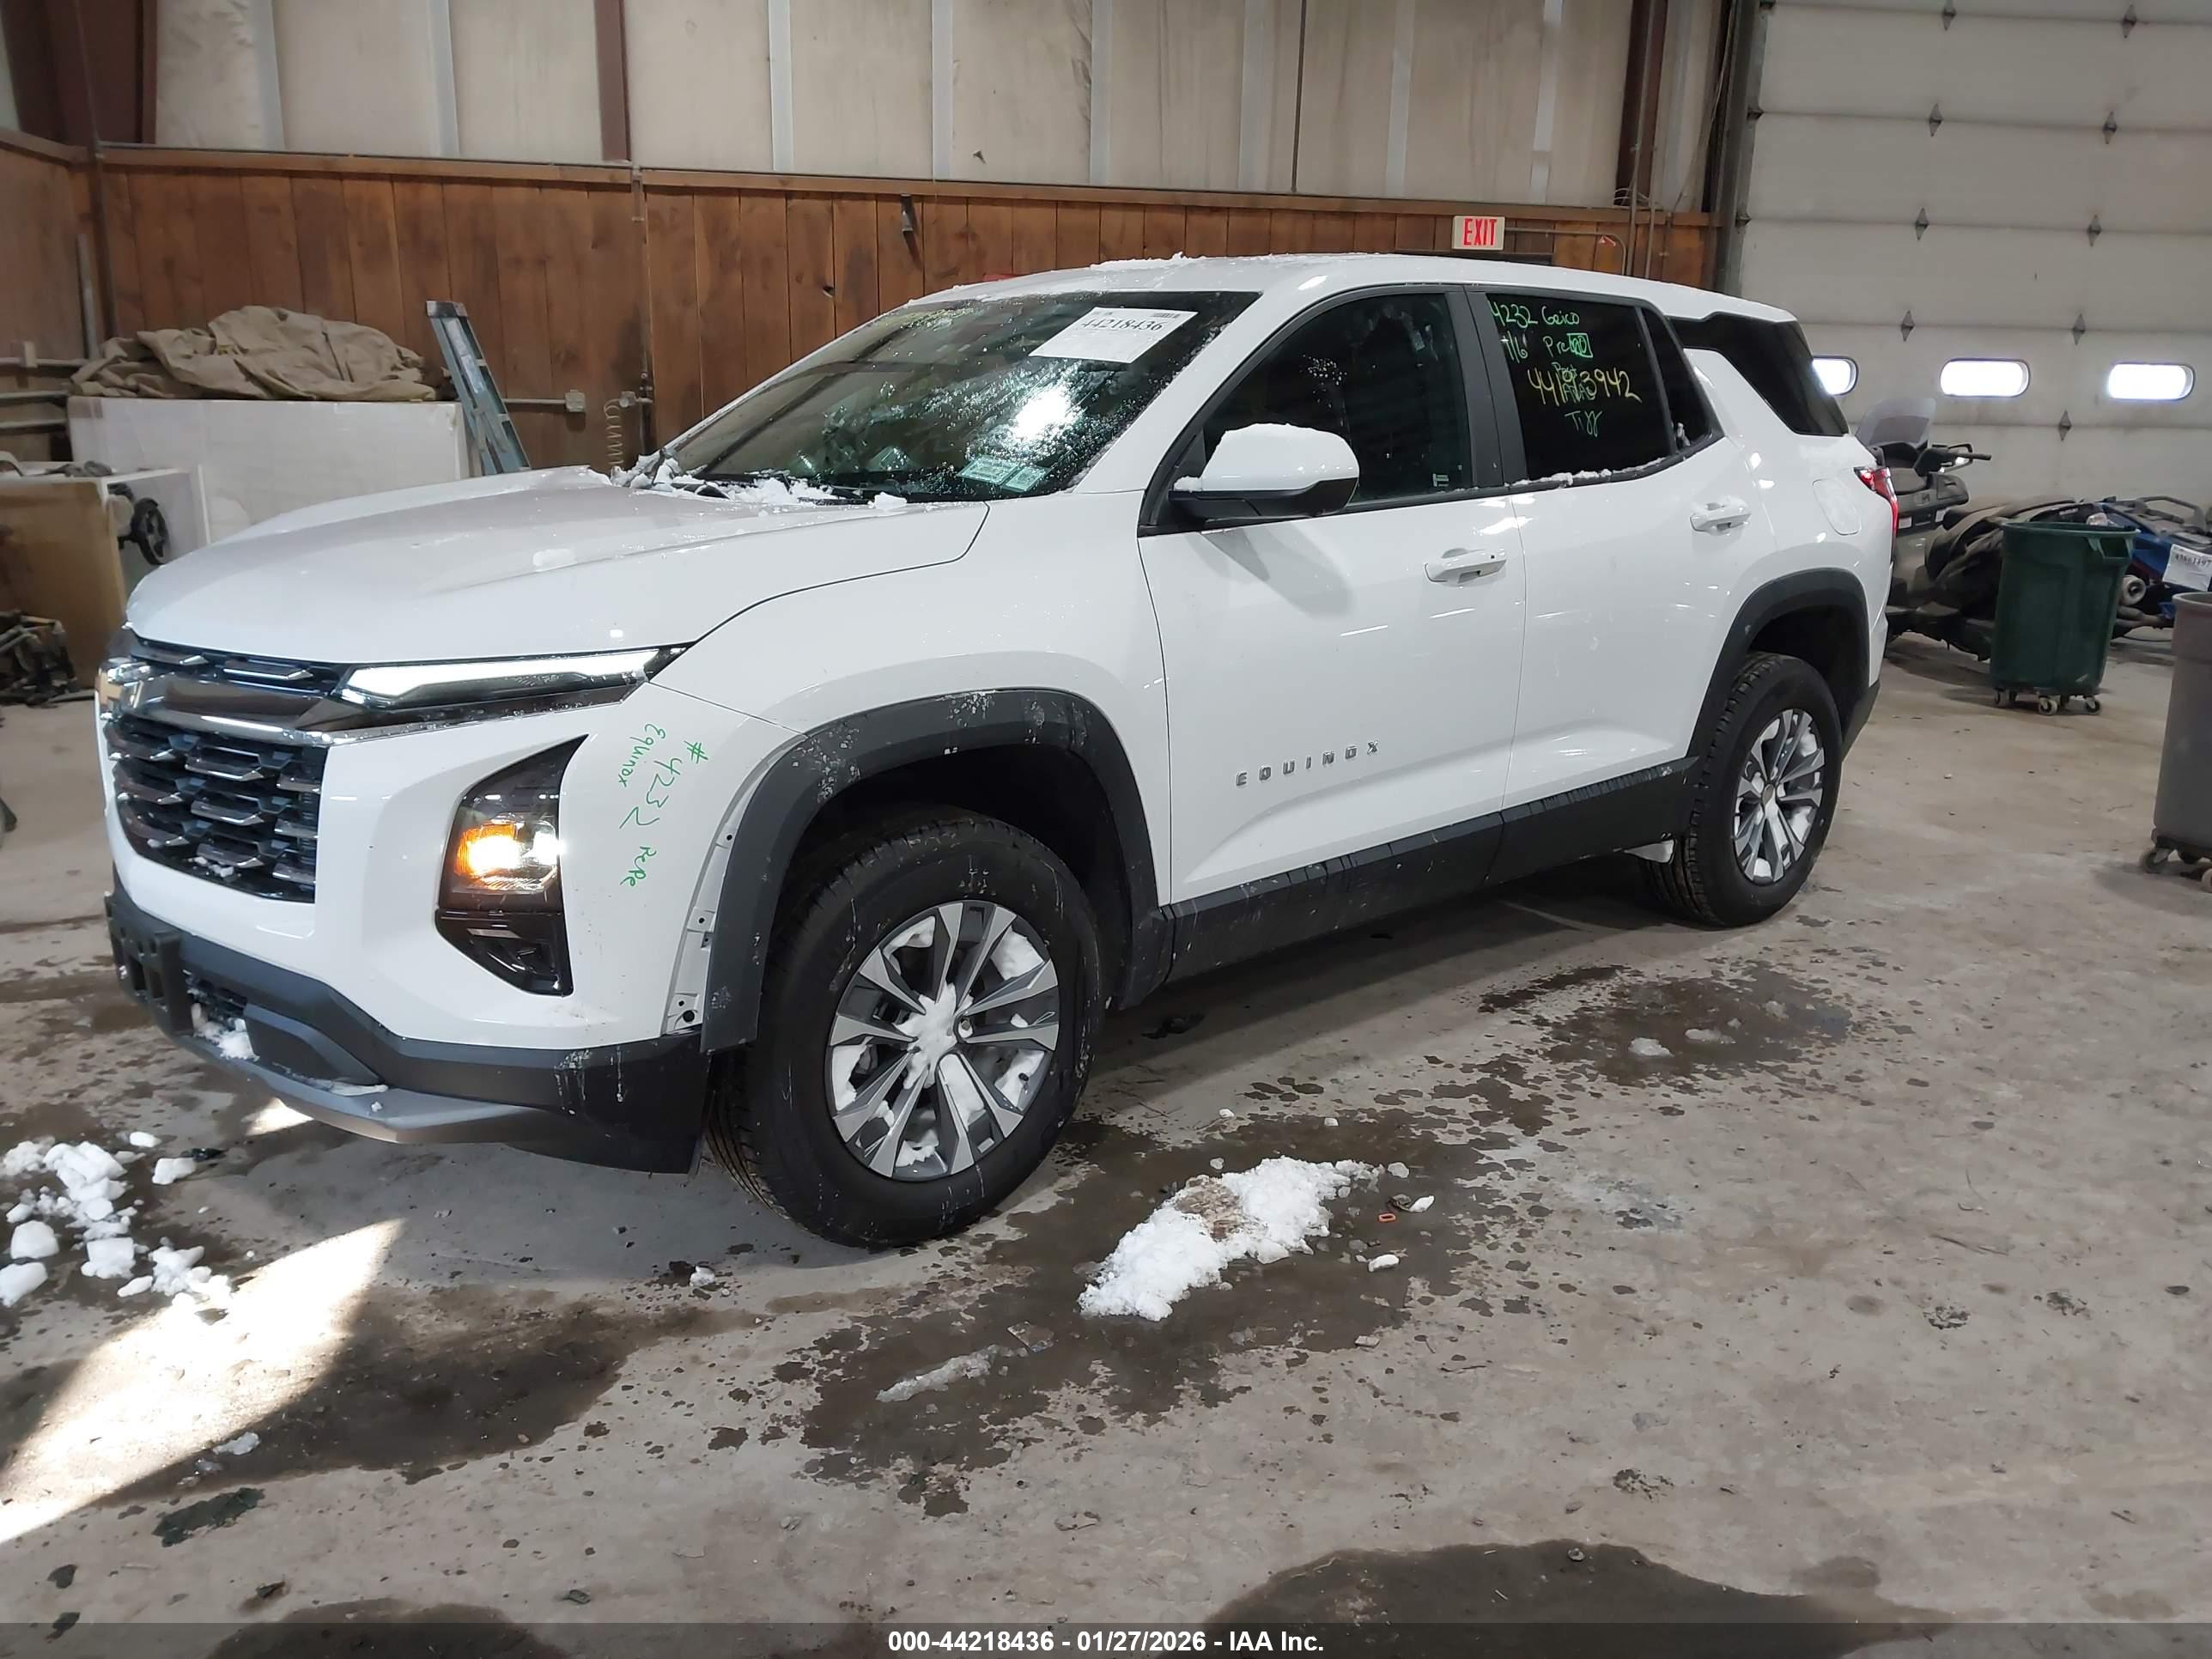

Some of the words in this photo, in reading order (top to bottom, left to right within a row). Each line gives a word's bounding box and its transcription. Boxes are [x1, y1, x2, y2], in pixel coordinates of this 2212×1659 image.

[1463, 218, 1498, 246] EXIT
[1080, 319, 1166, 331] 44218436
[1489, 301, 1538, 328] 4232
[1541, 305, 1580, 325] Geico
[617, 723, 666, 787] Equinox
[1236, 741, 1379, 787] EQUINOX
